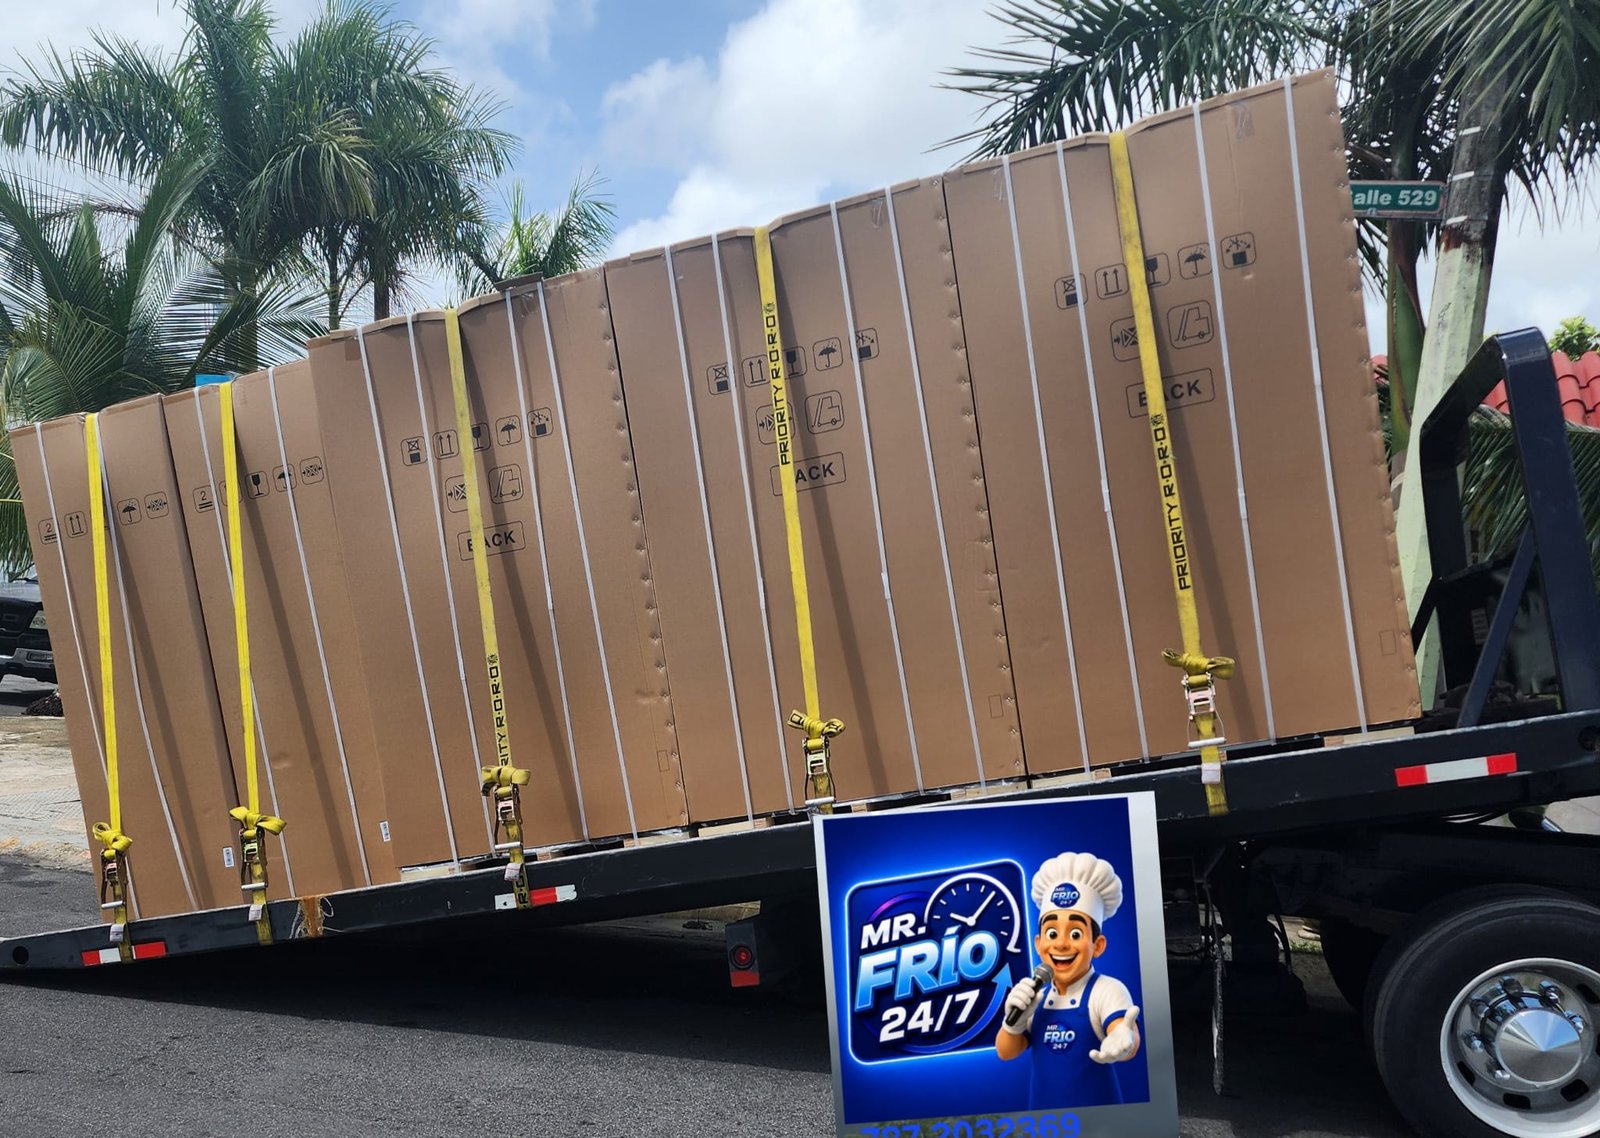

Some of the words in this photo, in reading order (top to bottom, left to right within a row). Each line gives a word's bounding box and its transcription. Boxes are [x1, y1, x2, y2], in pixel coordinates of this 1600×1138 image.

[1351, 189, 1392, 206] alle
[1398, 190, 1437, 206] 529
[773, 385, 791, 466] PRIORITY
[795, 462, 835, 484] ACK
[1166, 503, 1191, 590] PRIORITY
